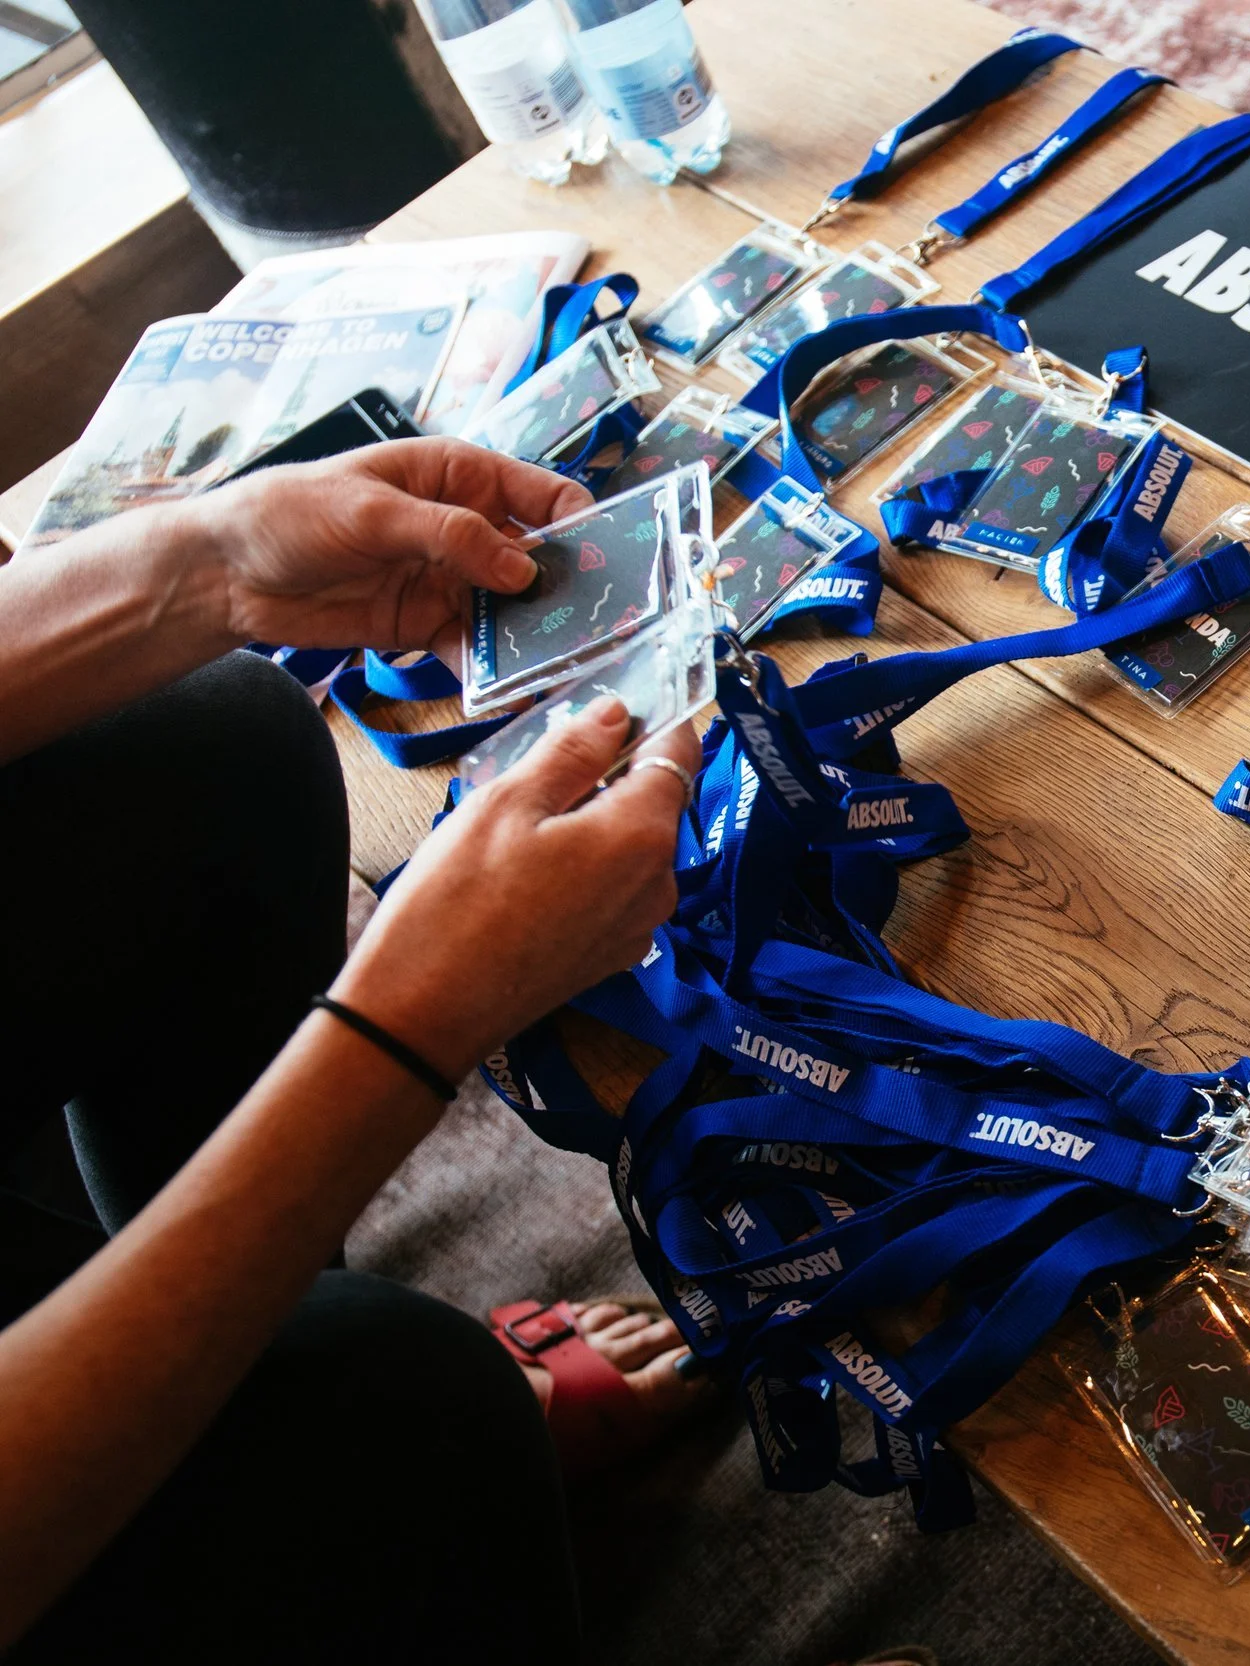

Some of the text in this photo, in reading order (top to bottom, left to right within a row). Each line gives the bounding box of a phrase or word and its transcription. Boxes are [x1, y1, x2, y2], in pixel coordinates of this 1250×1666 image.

[183, 331, 409, 365] COPENHAGEN
[198, 318, 378, 343] WELCOME TO
[1133, 443, 1183, 522] ABSOLUT.
[1120, 655, 1148, 680] TINA
[847, 796, 914, 831] ABSOLUT.
[731, 1024, 851, 1094] ABSOLUT.
[968, 1112, 1096, 1162] ABSOLUT.
[824, 1330, 913, 1418] ABSOLUT.
